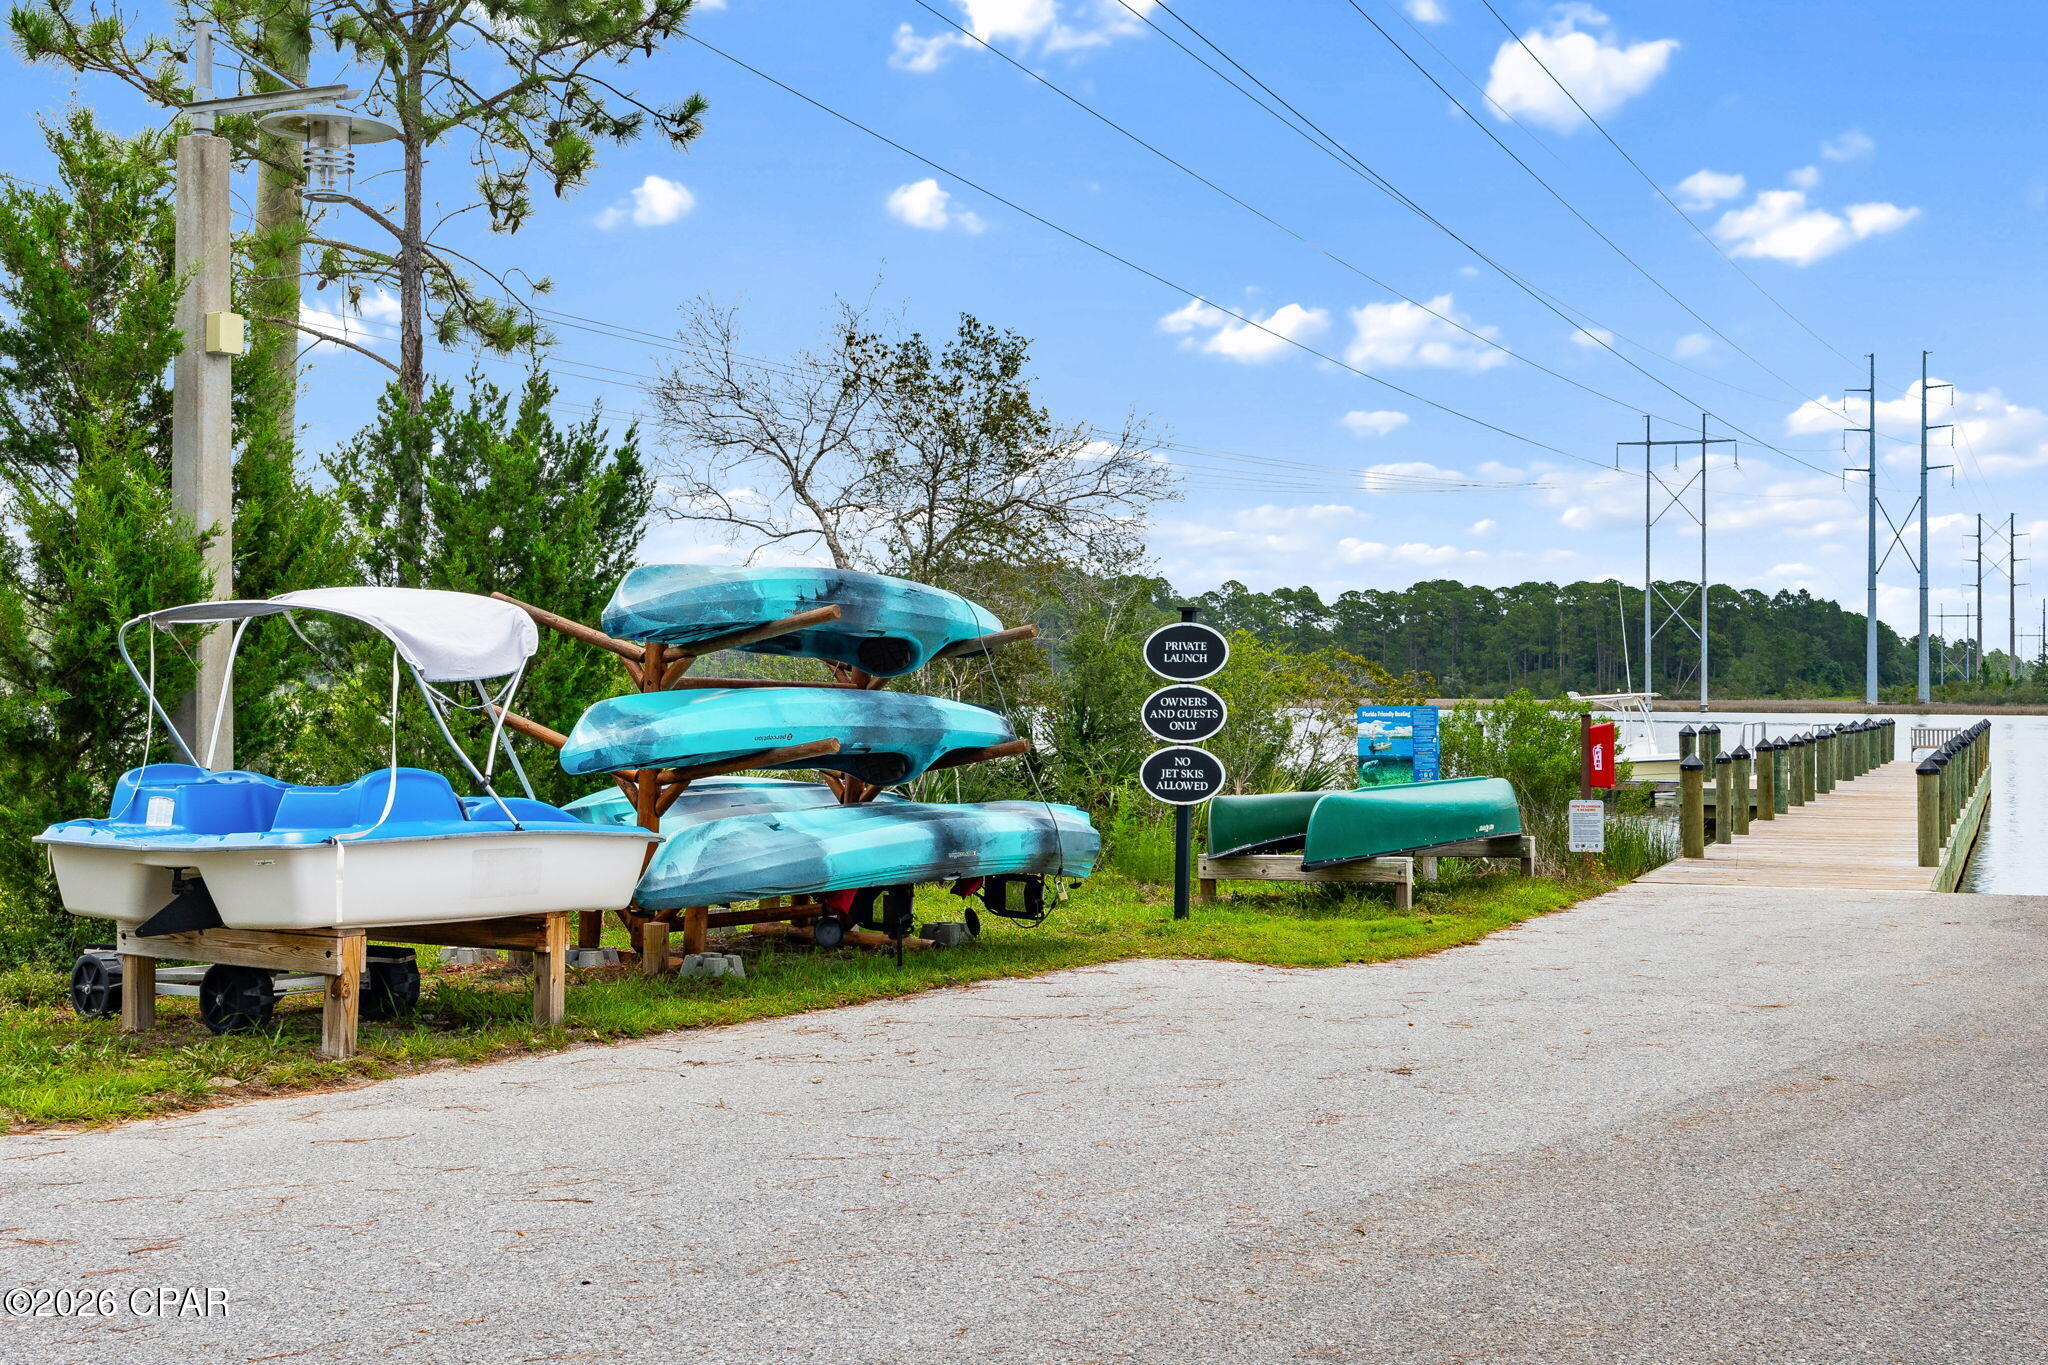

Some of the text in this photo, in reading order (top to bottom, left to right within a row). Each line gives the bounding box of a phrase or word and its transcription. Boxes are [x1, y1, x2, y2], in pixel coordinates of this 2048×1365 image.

[1165, 641, 1207, 651] PRIVATE
[1164, 653, 1208, 663] LAUNCH
[1160, 697, 1208, 706] OWNERS
[1150, 709, 1219, 719] AND GUESTS
[1169, 721, 1198, 731] ONLY
[754, 733, 787, 741] perception
[1174, 757, 1191, 767] NO
[1160, 769, 1204, 779] JET SKIS
[1156, 781, 1208, 791] ALLOWED
